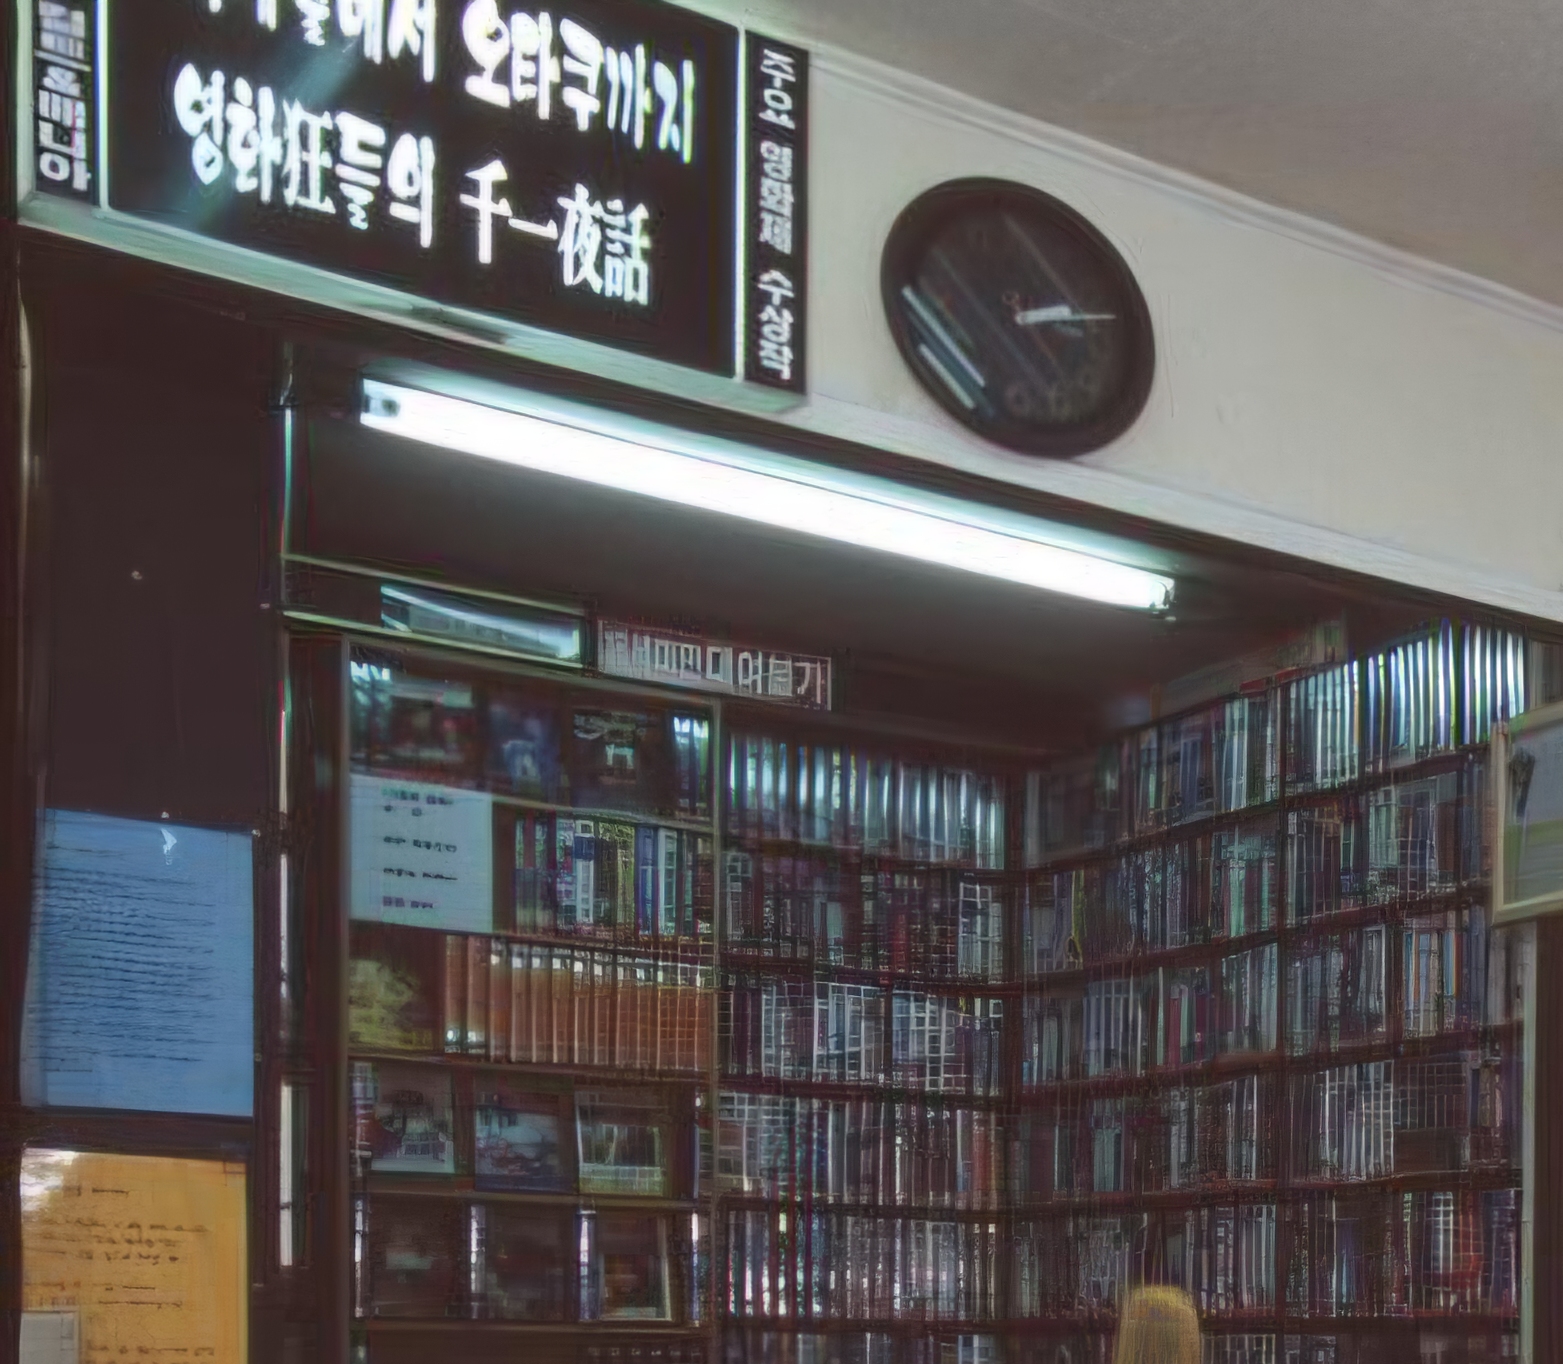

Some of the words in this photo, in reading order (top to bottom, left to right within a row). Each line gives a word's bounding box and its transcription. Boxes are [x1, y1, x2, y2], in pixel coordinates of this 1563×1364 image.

[173, 62, 437, 248] 영화狂들의
[460, 159, 651, 306] 千一夜話
[462, 0, 696, 164] 오타쿠까지
